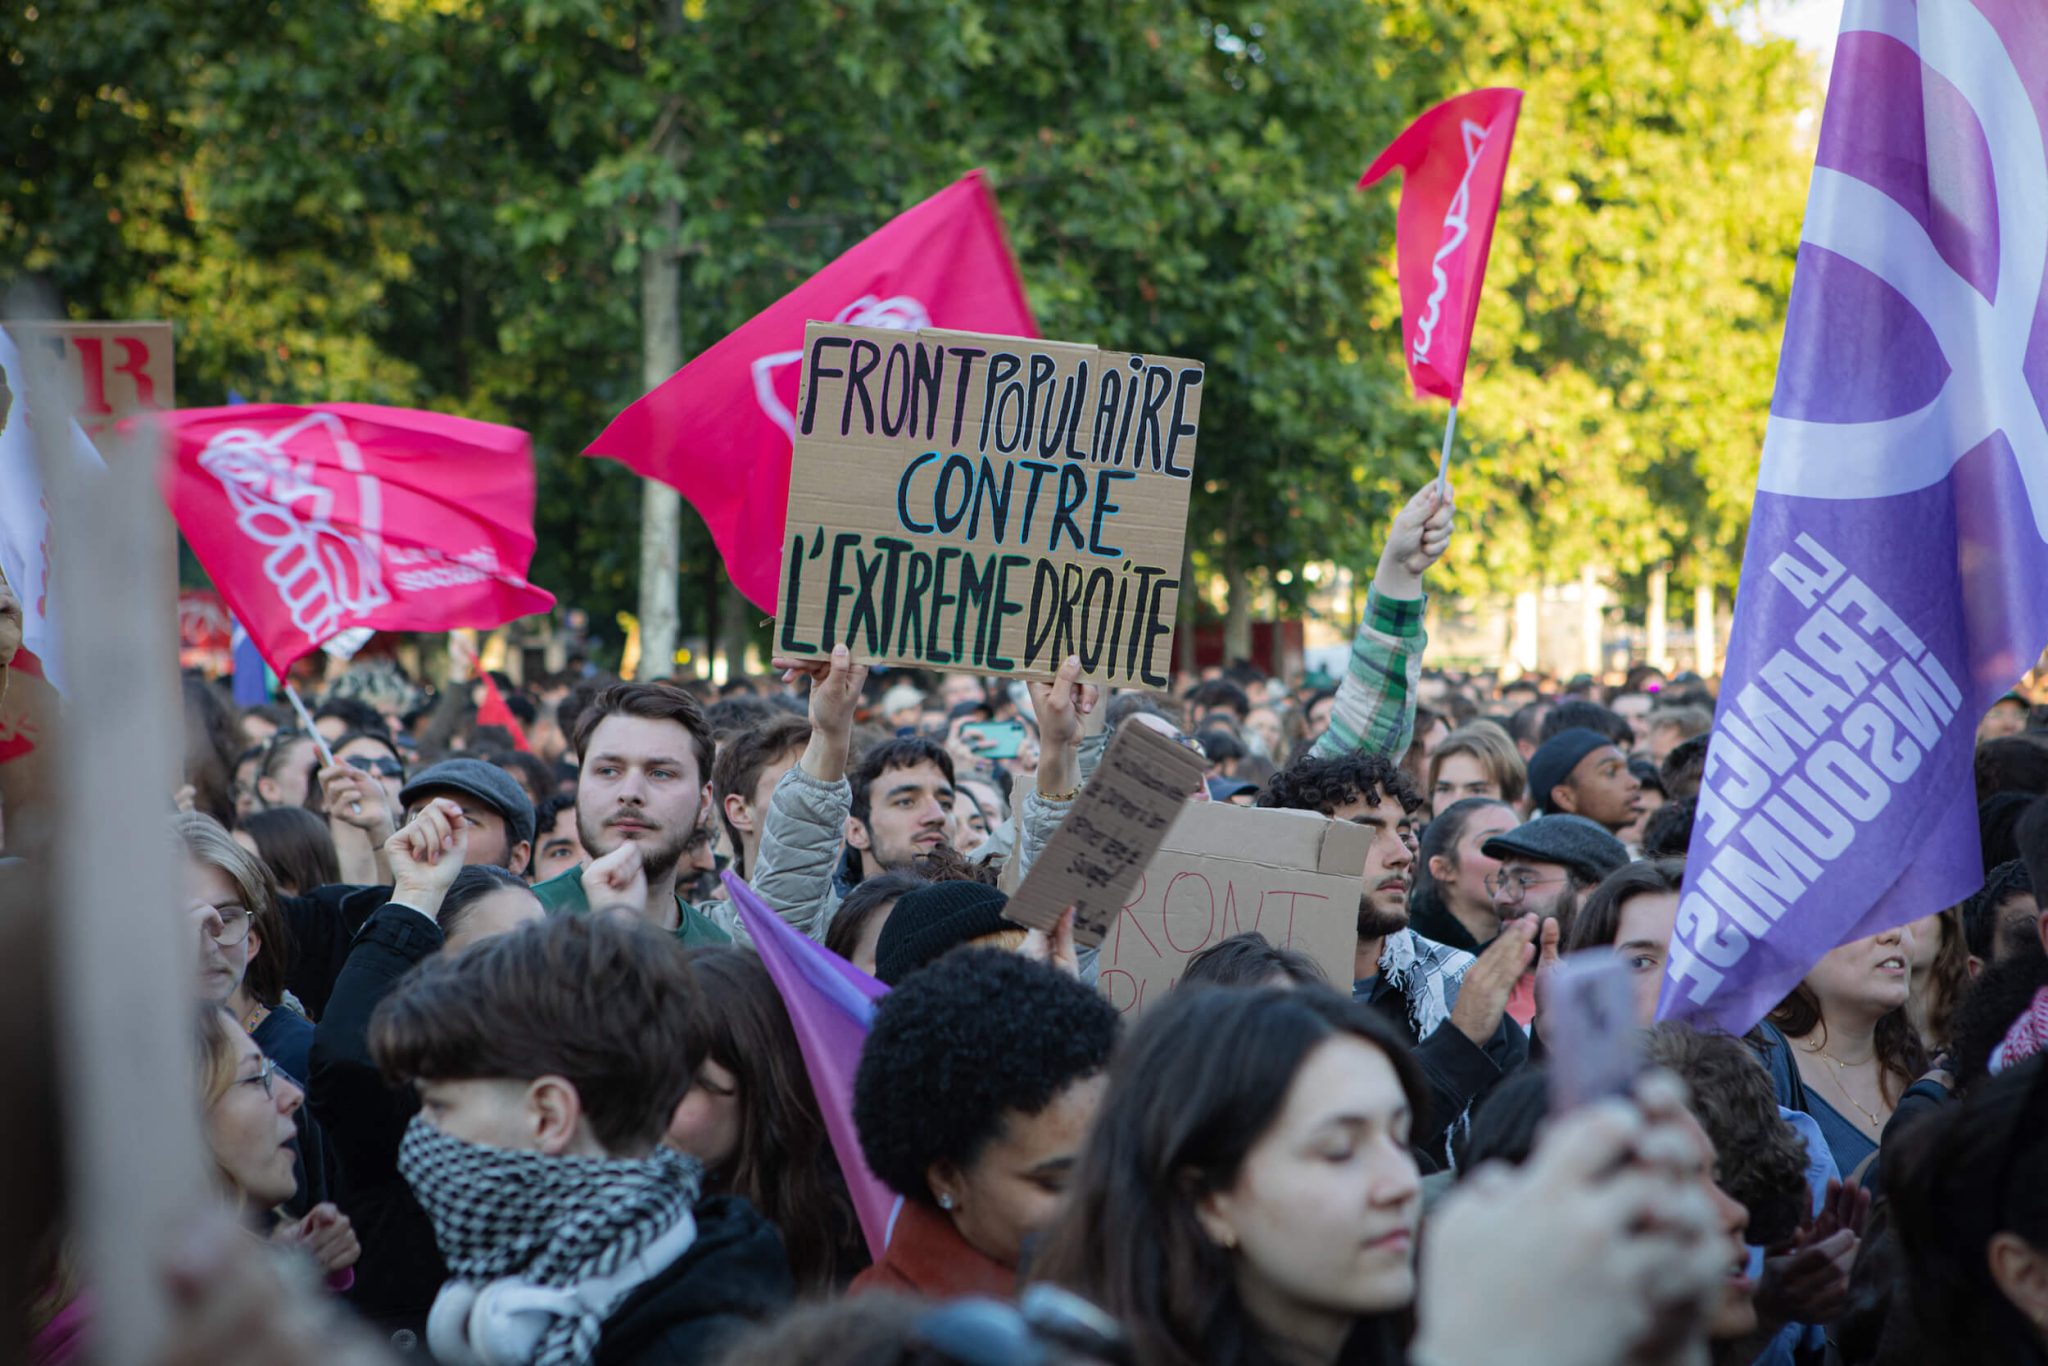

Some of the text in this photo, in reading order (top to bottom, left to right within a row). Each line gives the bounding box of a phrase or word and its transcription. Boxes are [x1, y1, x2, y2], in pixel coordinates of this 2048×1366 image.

[800, 336, 987, 447] FRONT
[898, 451, 1137, 557] CONTRE
[780, 525, 1031, 671] L'EXTREME
